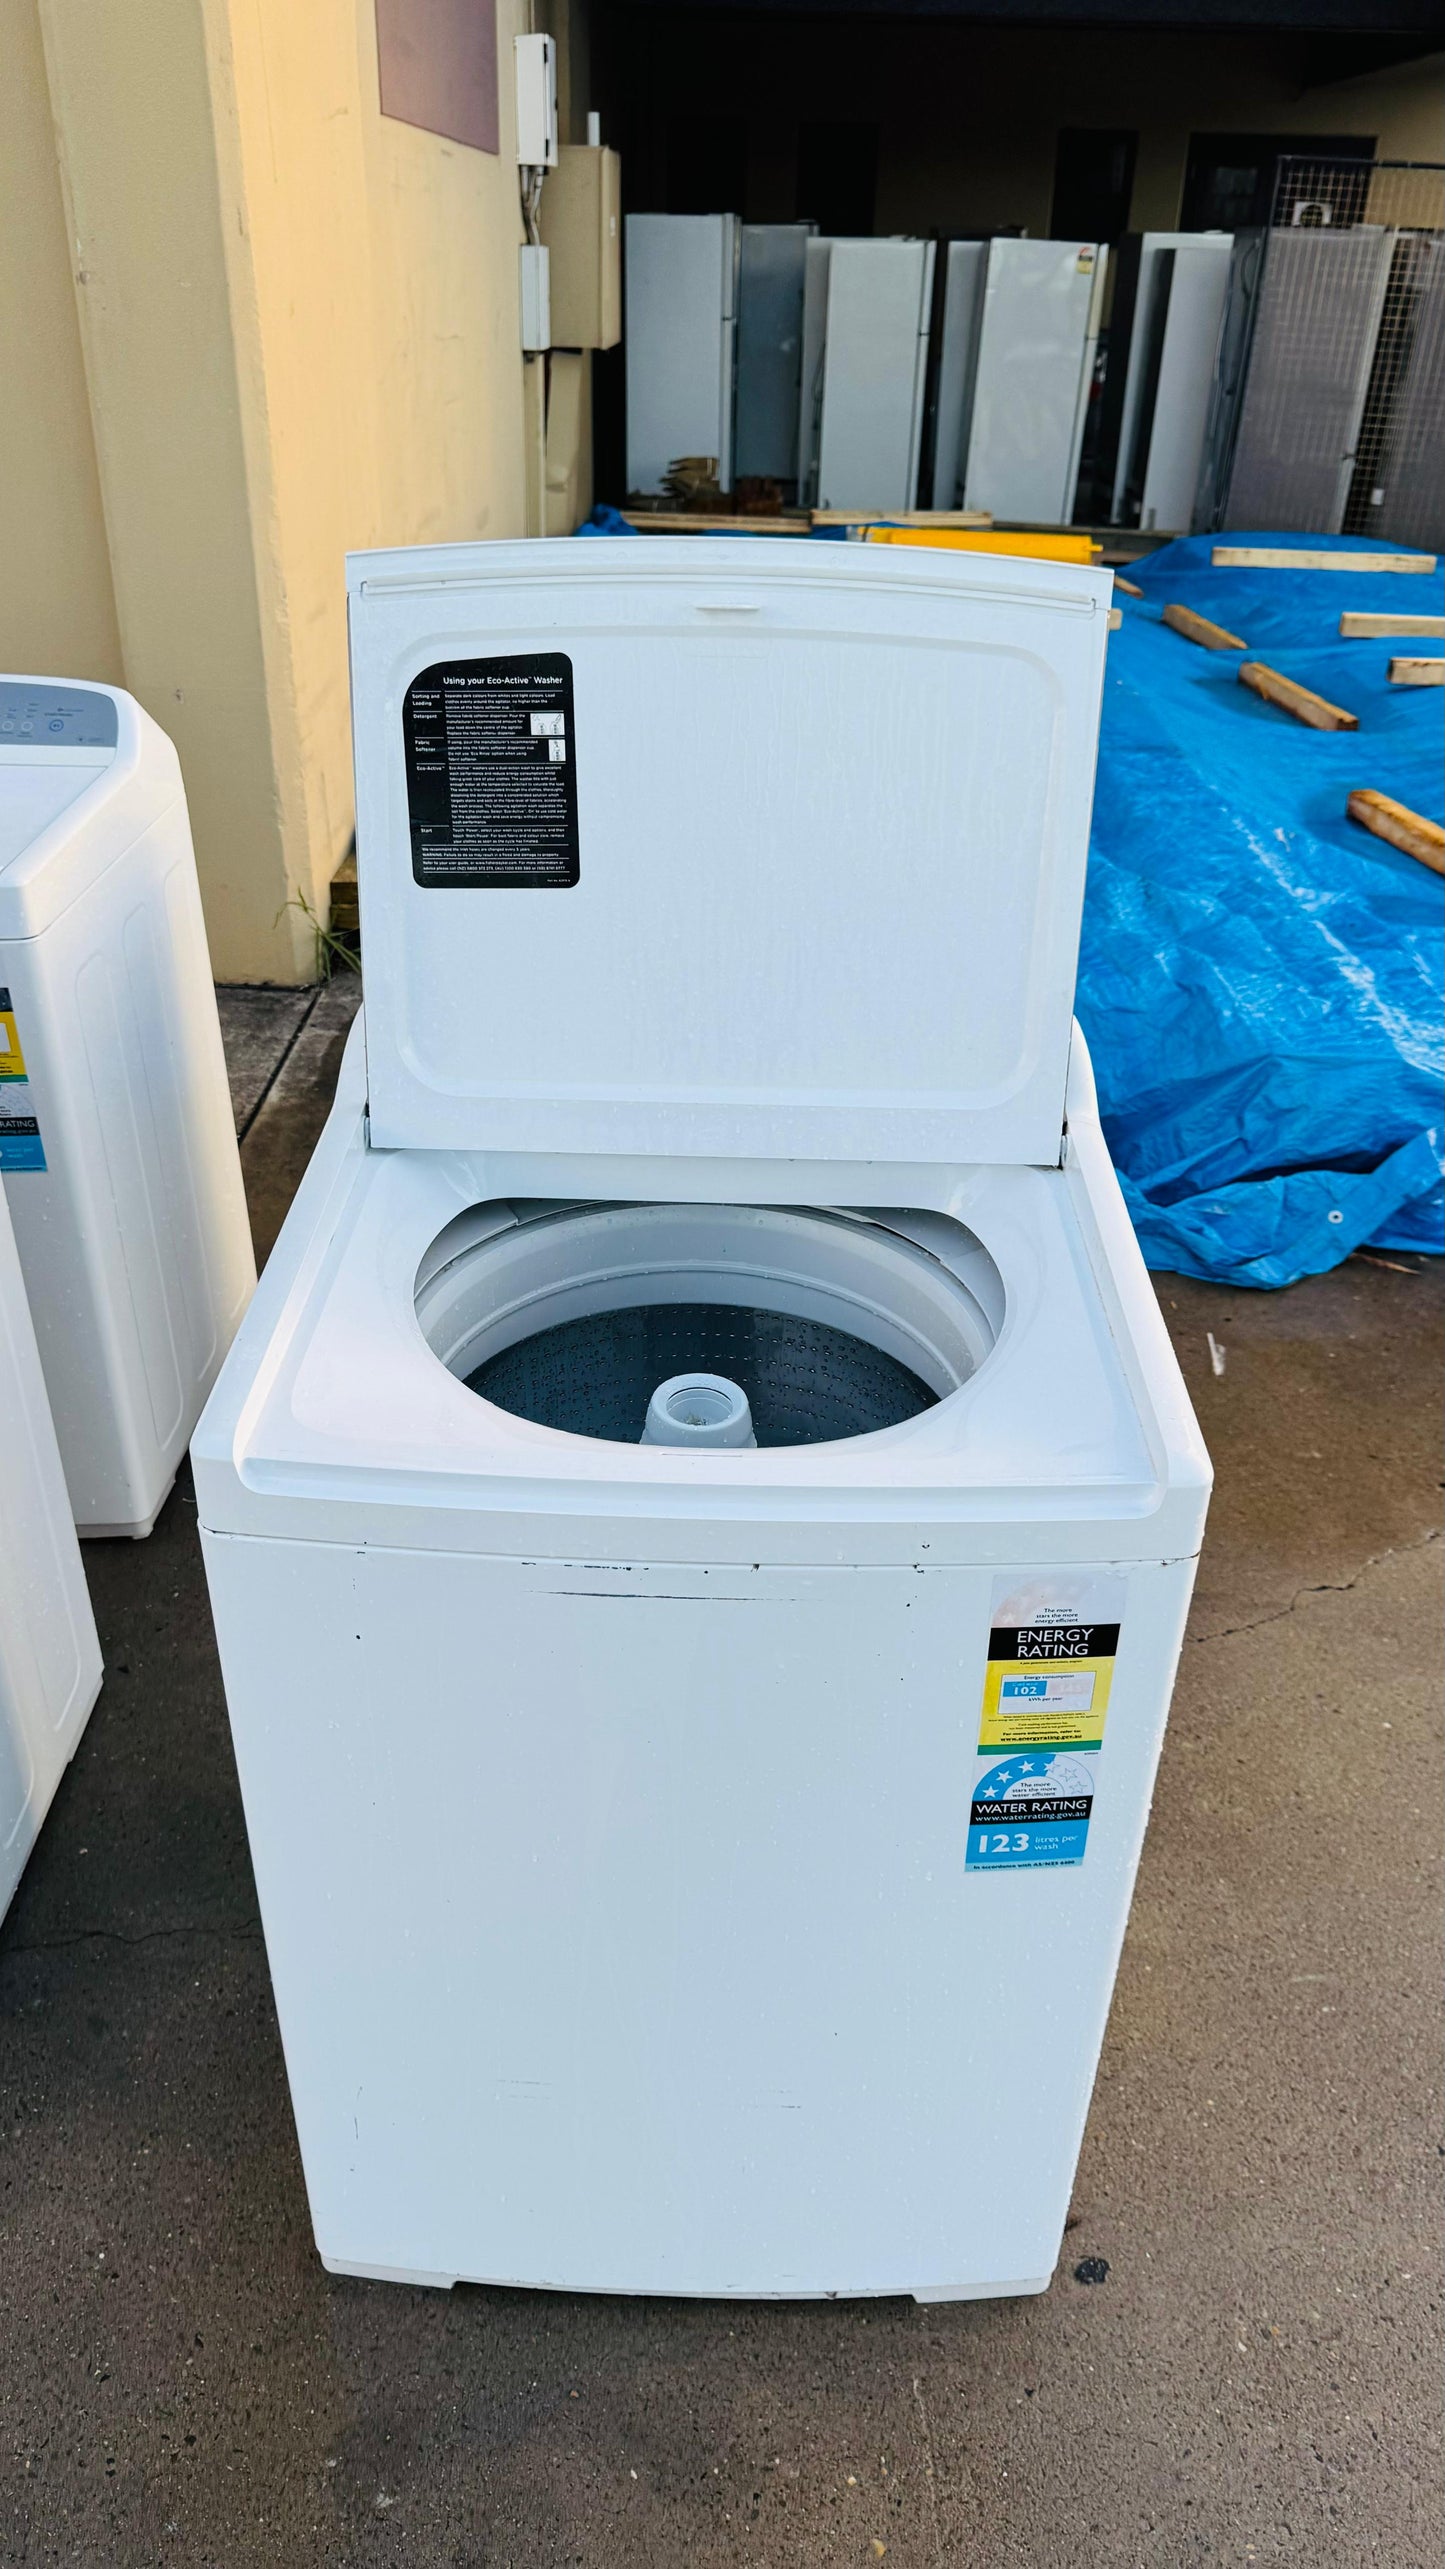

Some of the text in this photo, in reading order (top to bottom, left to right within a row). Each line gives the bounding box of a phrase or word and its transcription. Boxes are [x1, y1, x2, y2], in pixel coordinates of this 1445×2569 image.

[443, 677, 563, 685] Using your Eco-Active™ Washer
[1017, 1628, 1094, 1642] ENERGY
[1018, 1643, 1089, 1657] RATING
[1014, 1687, 1037, 1695] 102
[976, 1800, 1087, 1814] WATER RATING
[976, 1811, 1086, 1822] www.waterrating.gov.au
[978, 1833, 1030, 1853] 123
